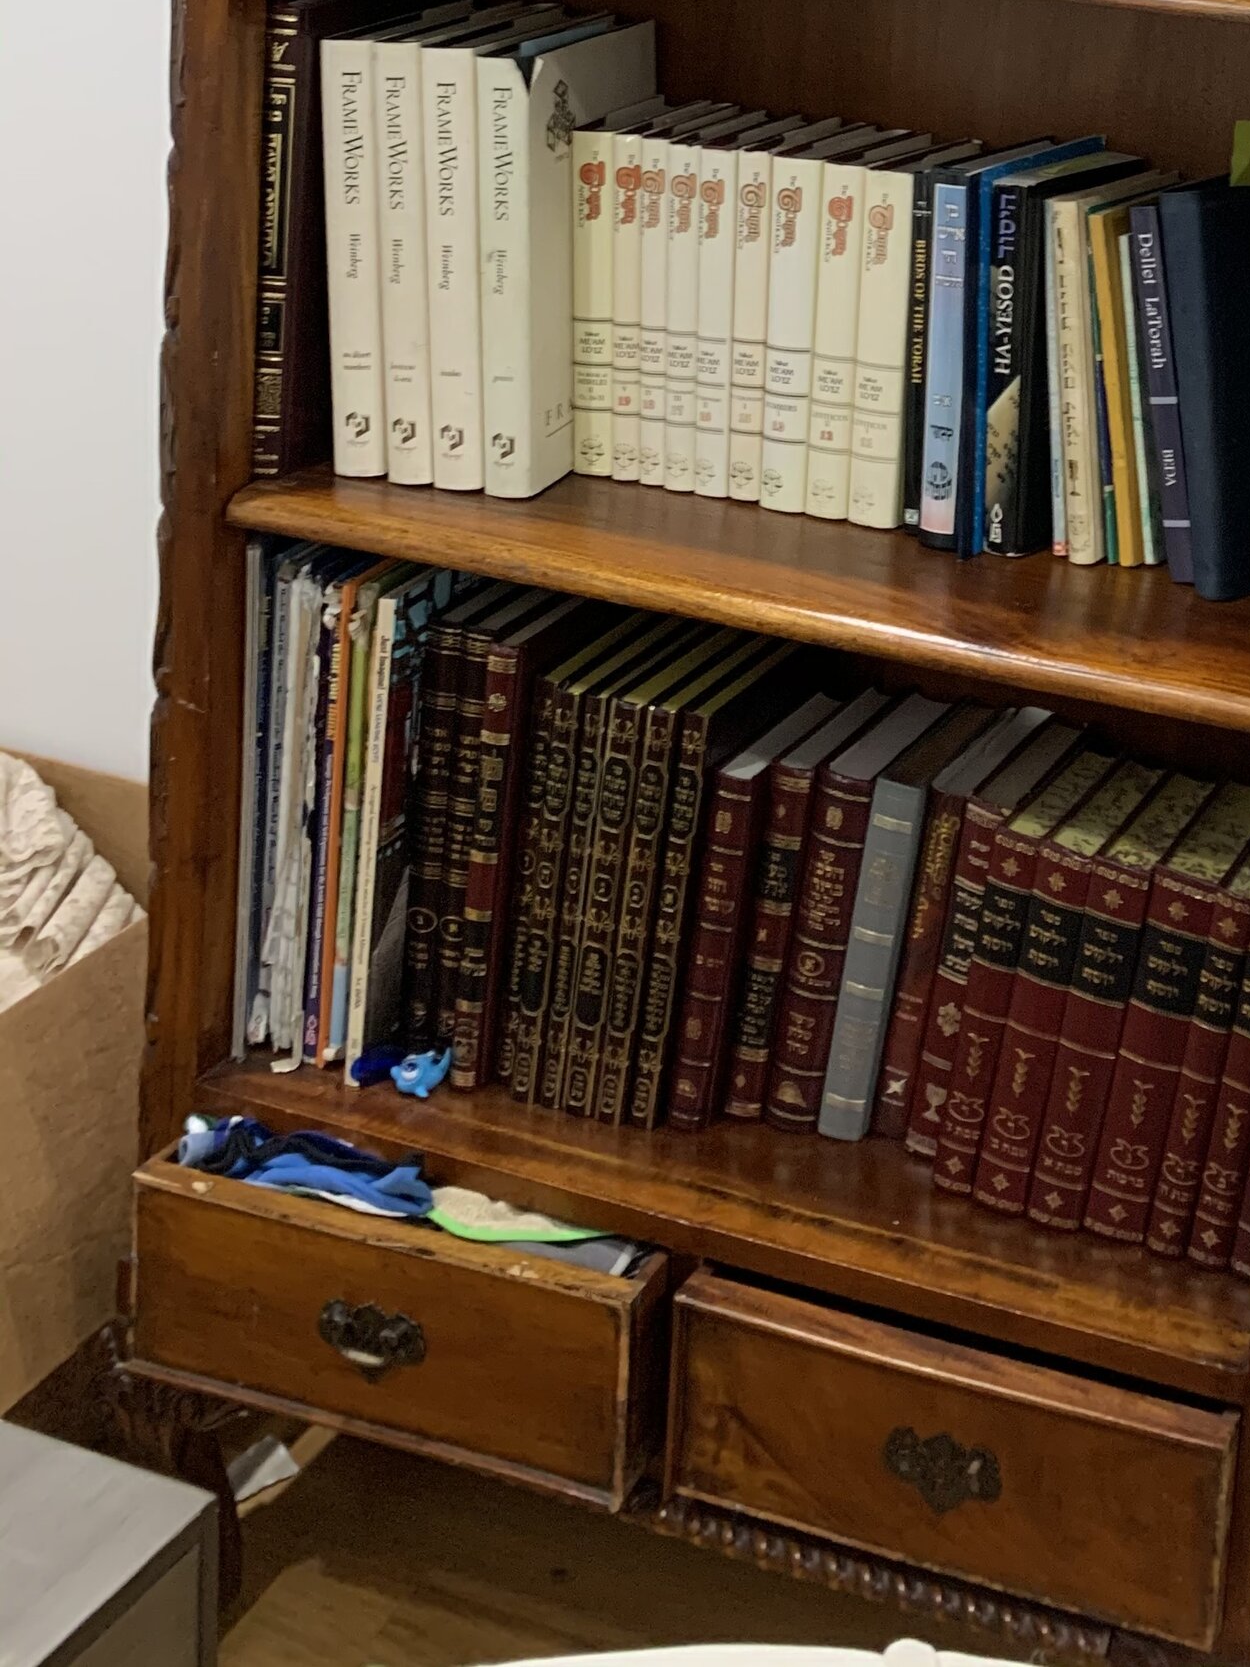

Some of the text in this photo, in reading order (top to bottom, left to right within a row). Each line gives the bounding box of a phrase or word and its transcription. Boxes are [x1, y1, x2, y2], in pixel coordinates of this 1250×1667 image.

[997, 194, 1017, 259] היסוד
[348, 233, 360, 279] Weinberg
[391, 239, 403, 284] Weinberg
[440, 244, 453, 291] Weinberg
[492, 249, 506, 296] Weinberg
[910, 239, 927, 384] BIRDS OF THE TORAH
[993, 265, 1015, 375] HA-YESOD
[1143, 297, 1167, 369] LaTorah
[377, 635, 390, 690] Just Imagine!
